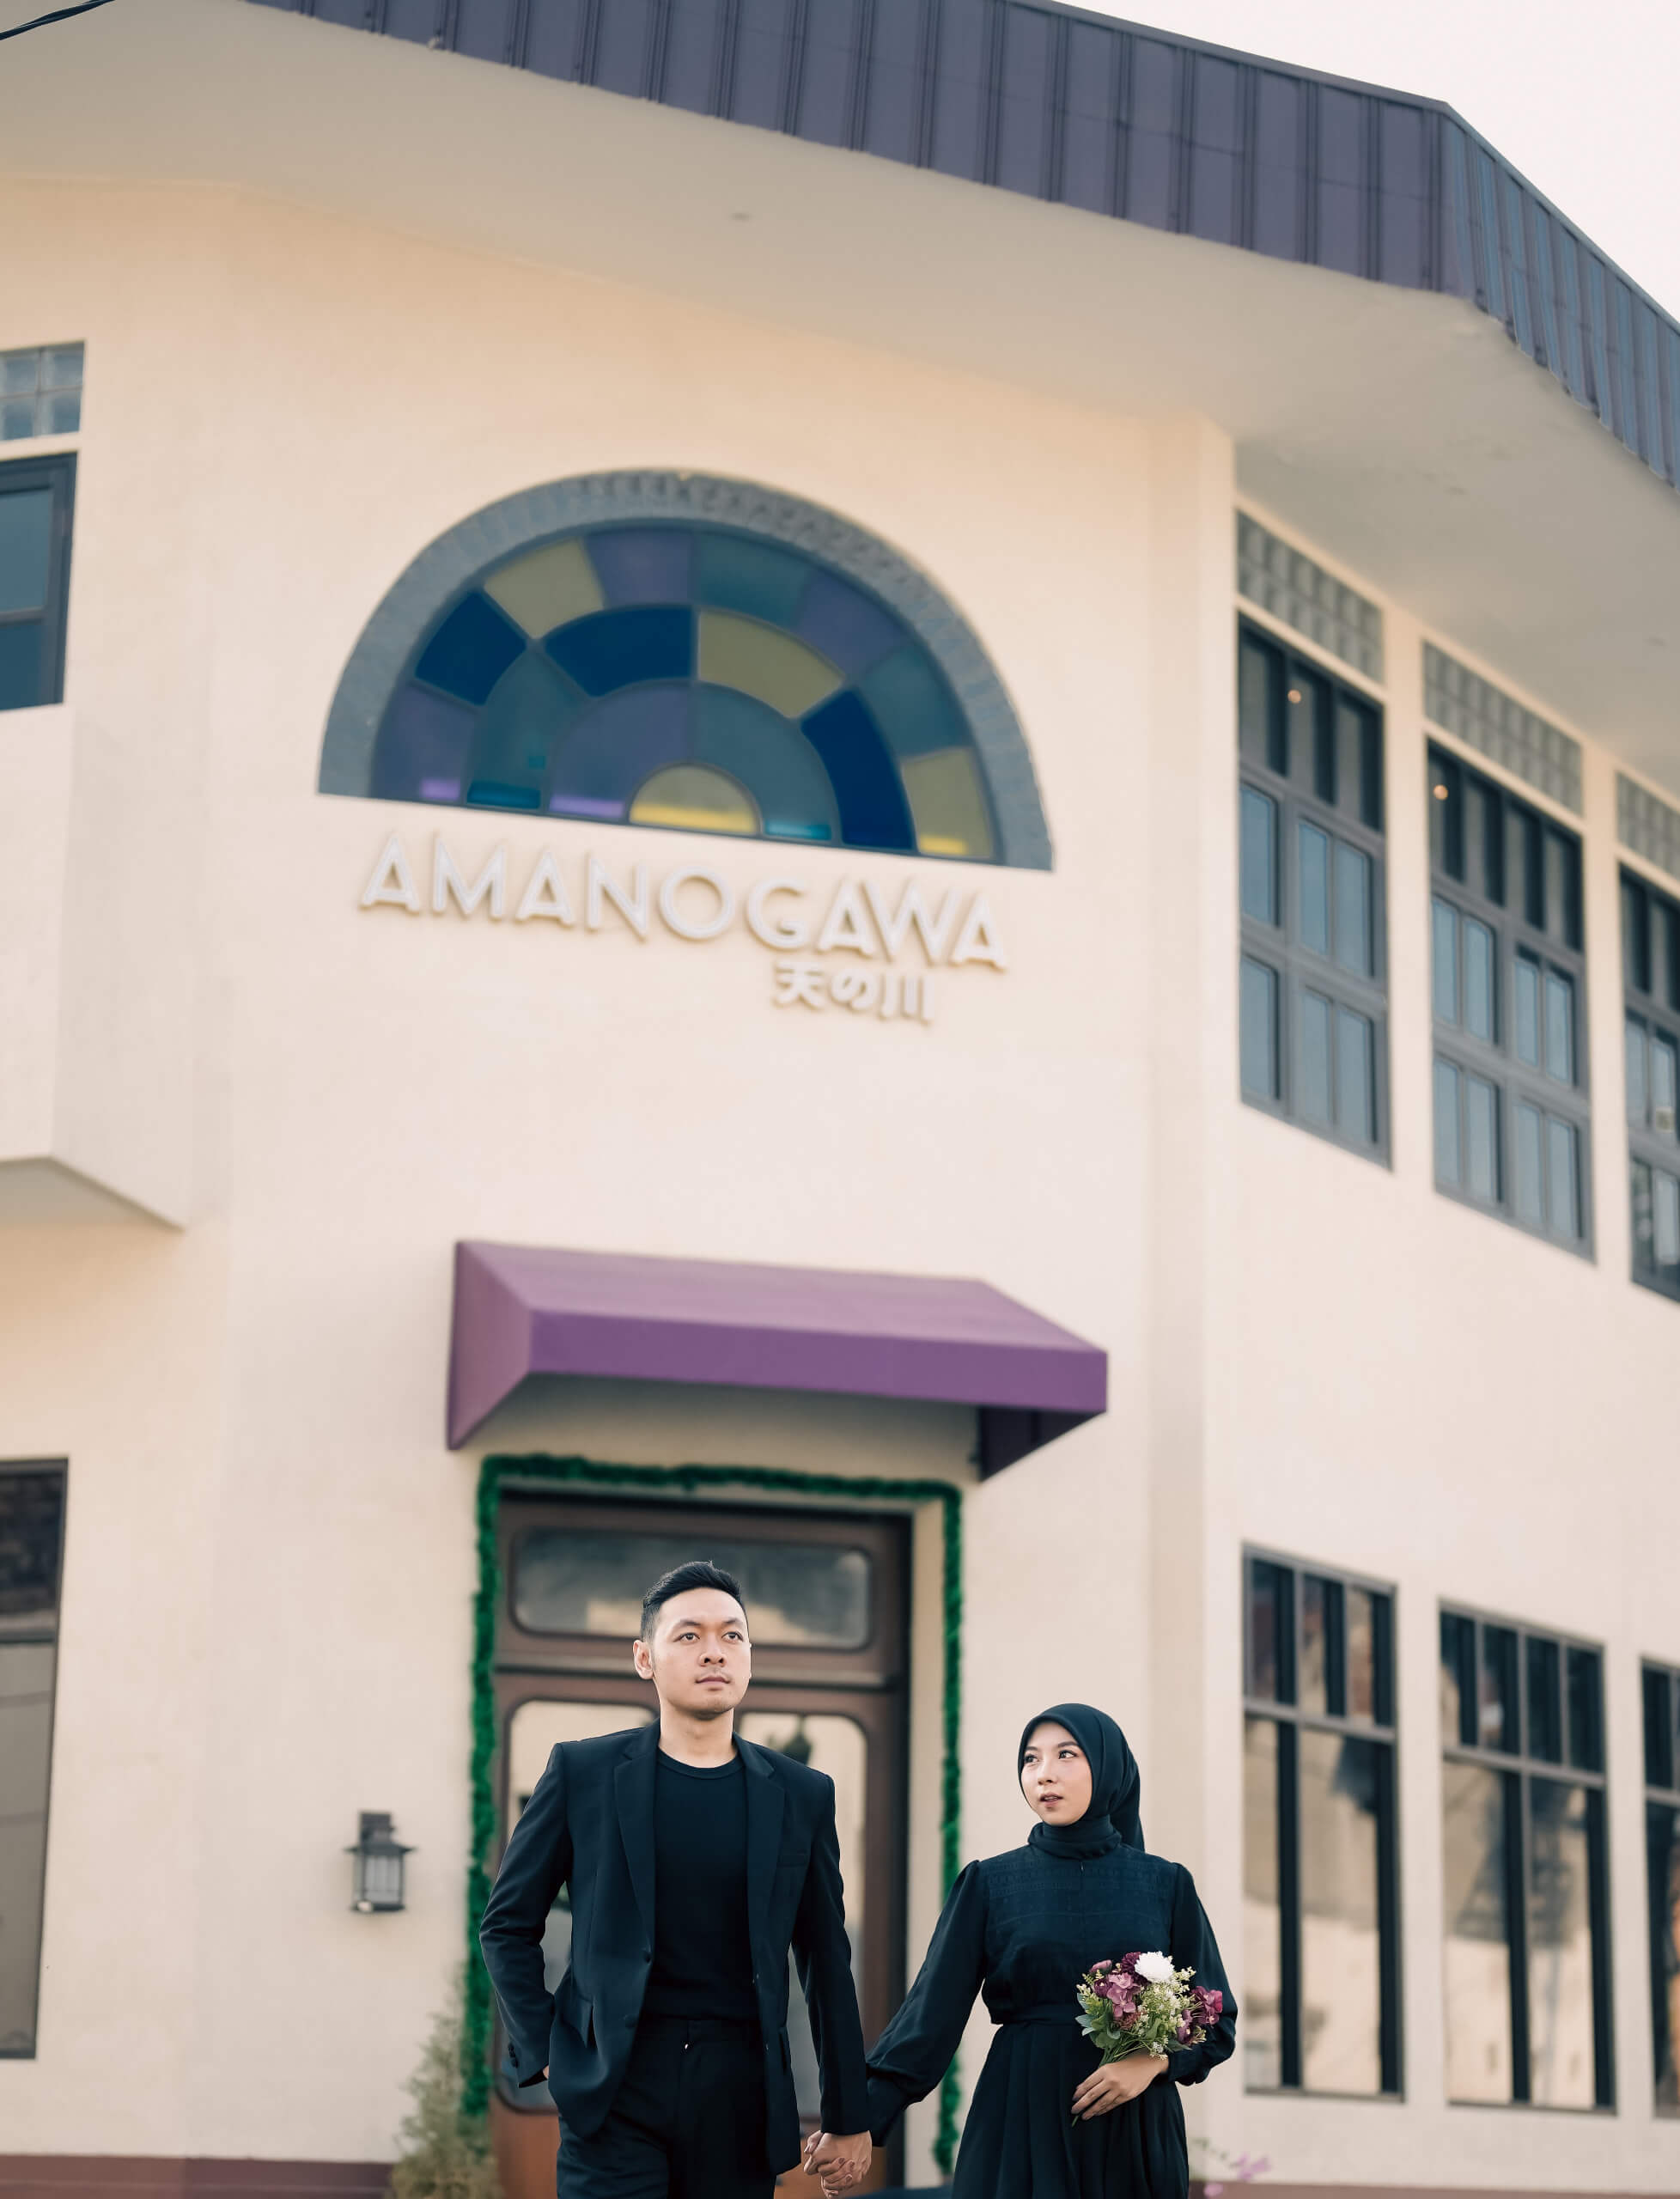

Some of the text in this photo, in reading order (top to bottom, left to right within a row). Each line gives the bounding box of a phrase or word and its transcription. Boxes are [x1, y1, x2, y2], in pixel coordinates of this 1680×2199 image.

[359, 831, 1007, 972] AMANOGAWA
[773, 959, 934, 1025] 天の川
